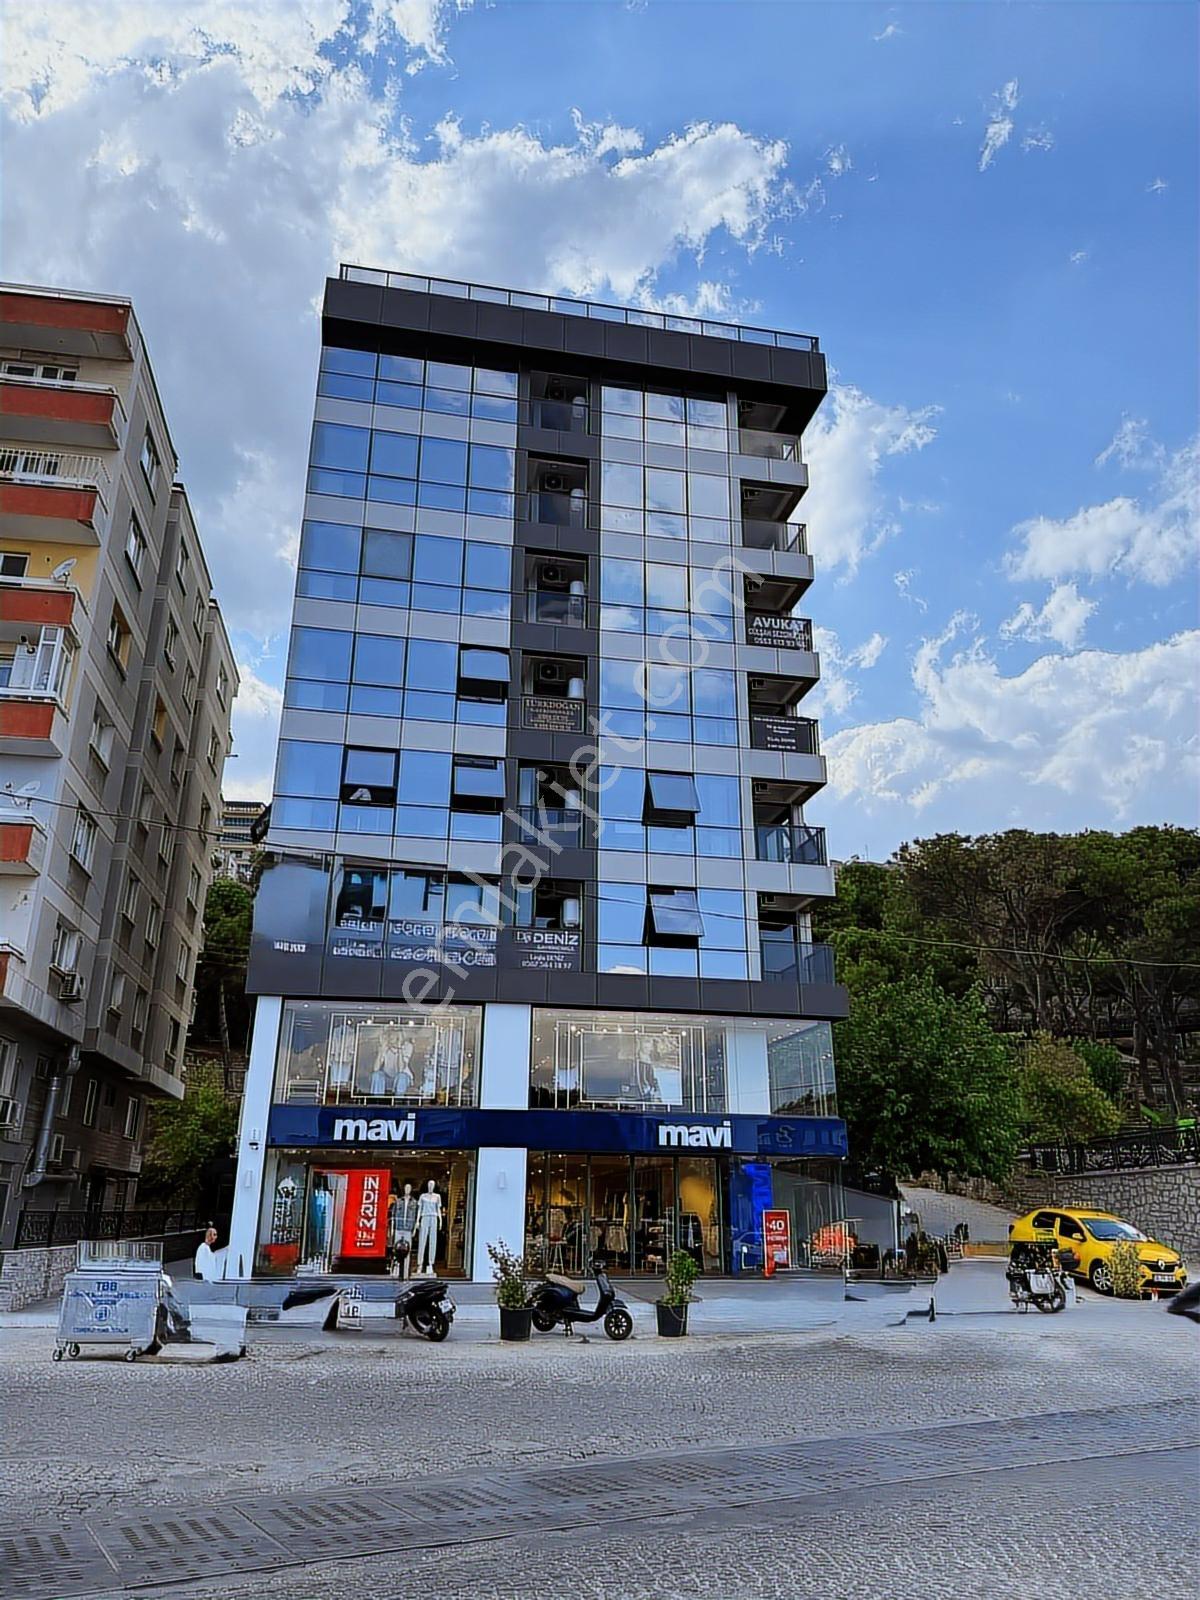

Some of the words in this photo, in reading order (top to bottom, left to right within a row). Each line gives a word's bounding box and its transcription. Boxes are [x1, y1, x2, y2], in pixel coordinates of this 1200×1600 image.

[753, 616, 804, 631] AVUKAT
[533, 930, 579, 945] DENİZ
[333, 1112, 416, 1141] mavi
[658, 1121, 732, 1147] mavi
